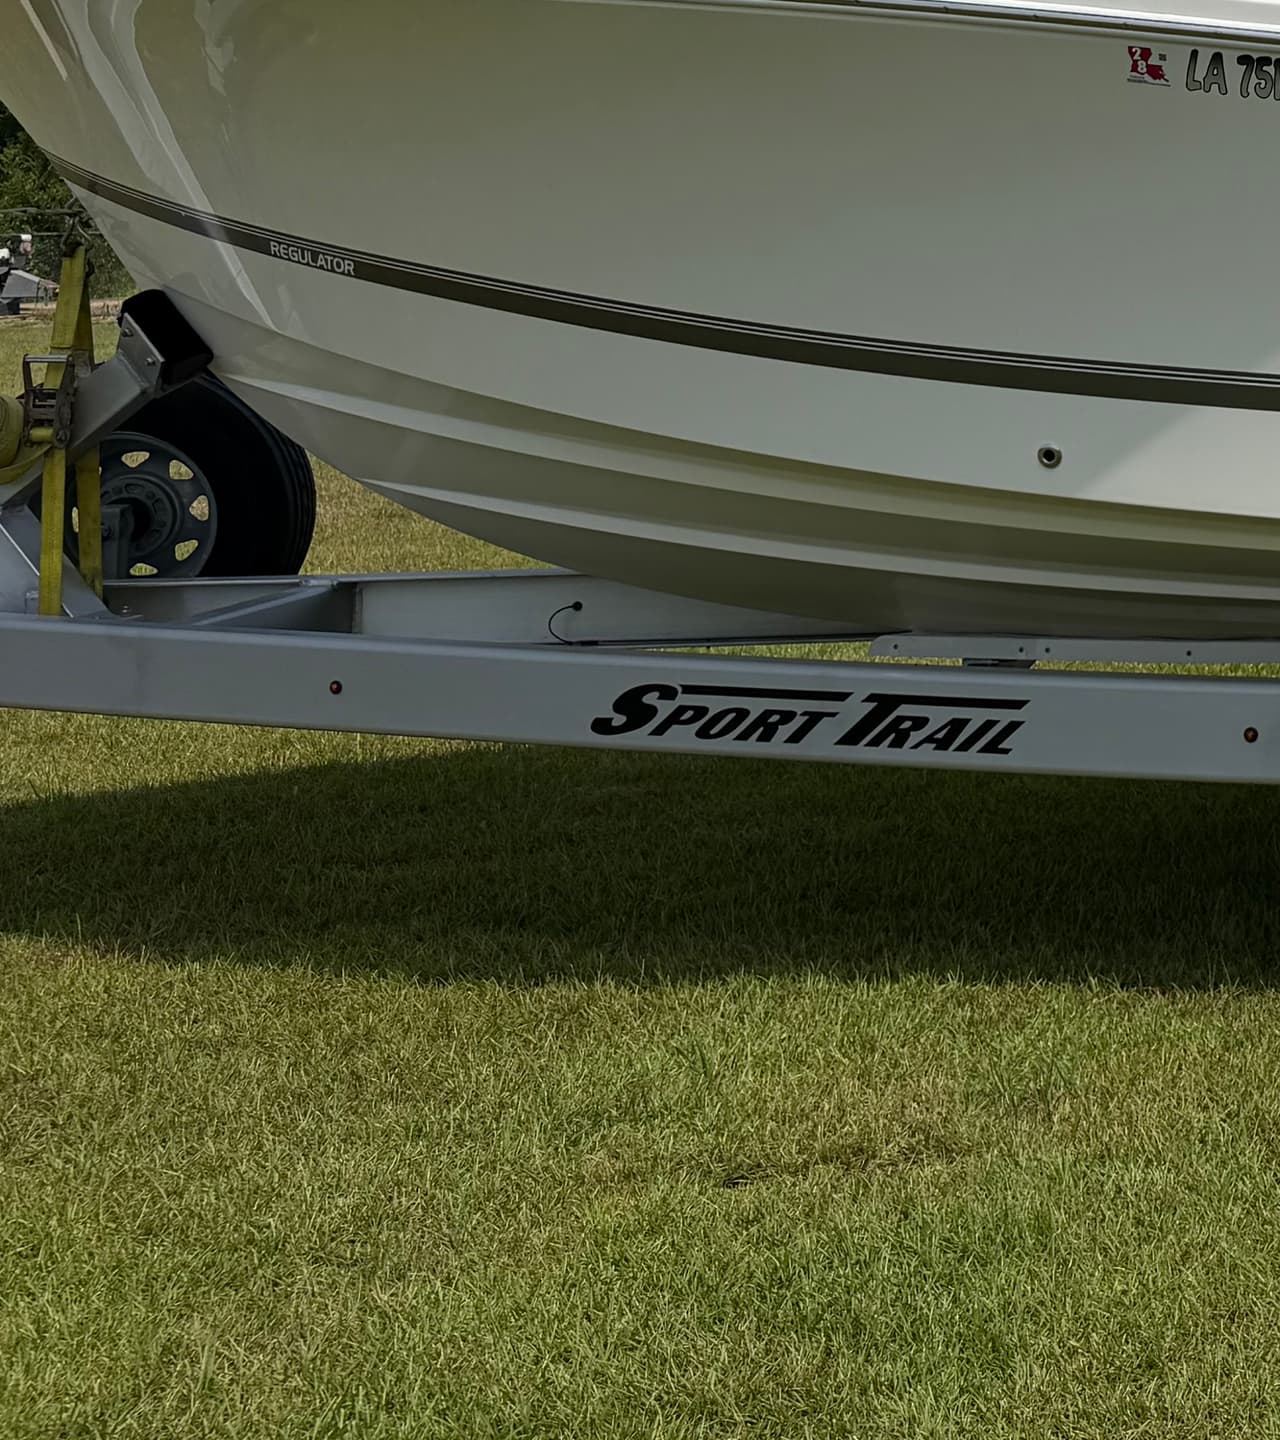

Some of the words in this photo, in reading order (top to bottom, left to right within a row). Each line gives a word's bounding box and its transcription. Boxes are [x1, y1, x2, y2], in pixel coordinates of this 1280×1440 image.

[1185, 49, 1228, 95] LA
[269, 241, 356, 276] REGULATOR
[590, 683, 841, 744] SPORT
[833, 692, 1031, 755] TRAIL
